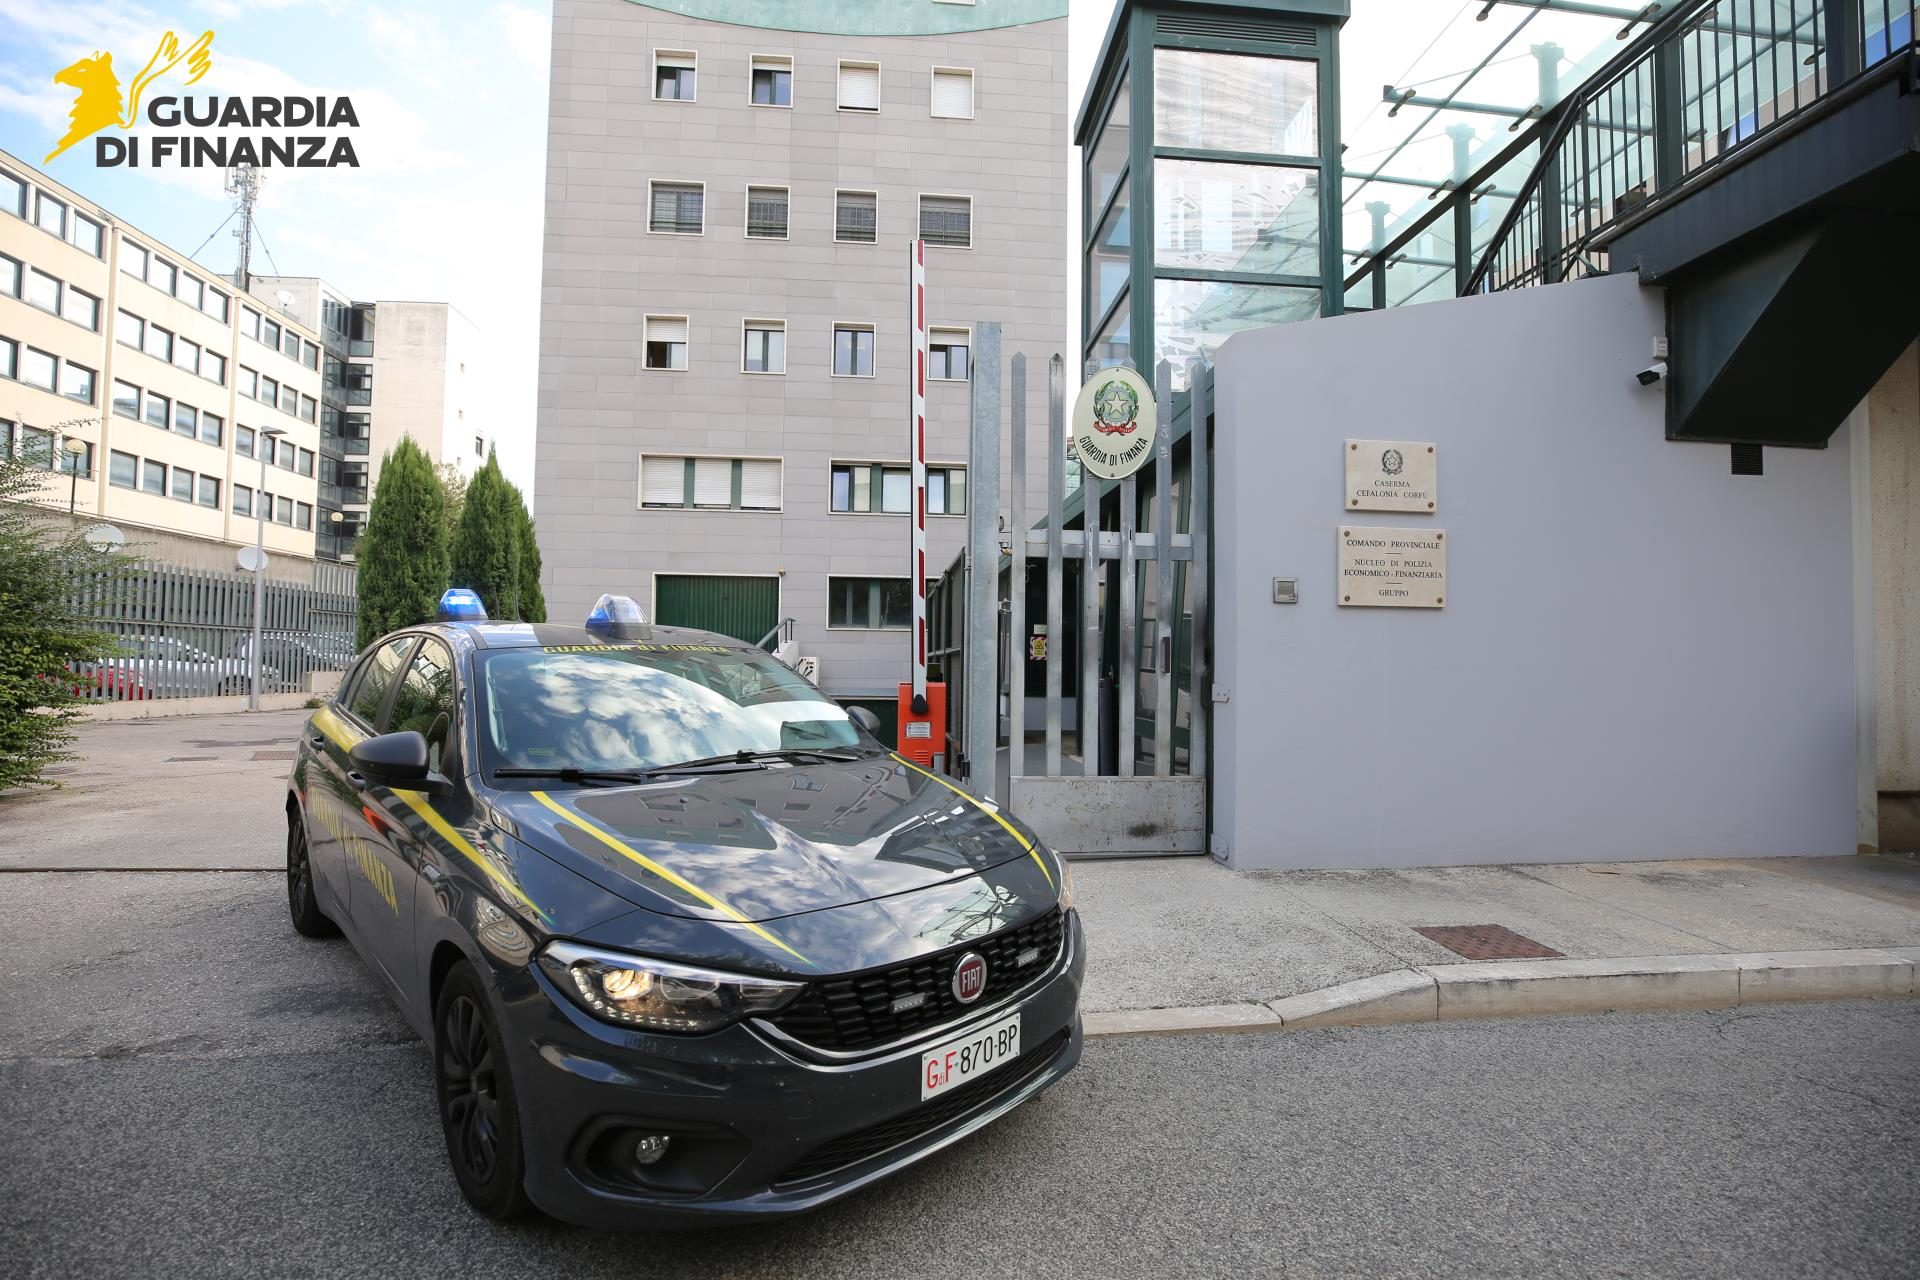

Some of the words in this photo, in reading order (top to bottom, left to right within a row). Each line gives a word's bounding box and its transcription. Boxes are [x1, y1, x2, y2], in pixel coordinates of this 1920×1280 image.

[1079, 435, 1108, 465] GUARDIA
[1109, 454, 1118, 466] DI
[1119, 437, 1149, 465] FINANZA
[1374, 479, 1410, 488] CASERMA
[1356, 489, 1399, 499] CEFALONIA
[1346, 539, 1386, 548] COMANDO
[1391, 540, 1440, 550] PROVINCIALE
[1354, 558, 1386, 567] NUCLEO
[1390, 559, 1399, 567] DI
[1404, 560, 1433, 568] POLIZIA
[1344, 569, 1390, 578] ECONOMICO
[1395, 570, 1443, 579] FINANZIARIA
[1378, 589, 1409, 598] GRUPPO
[543, 644, 633, 654] GUARDIA
[662, 644, 731, 653] FINANZA
[961, 966, 982, 993] FIAT
